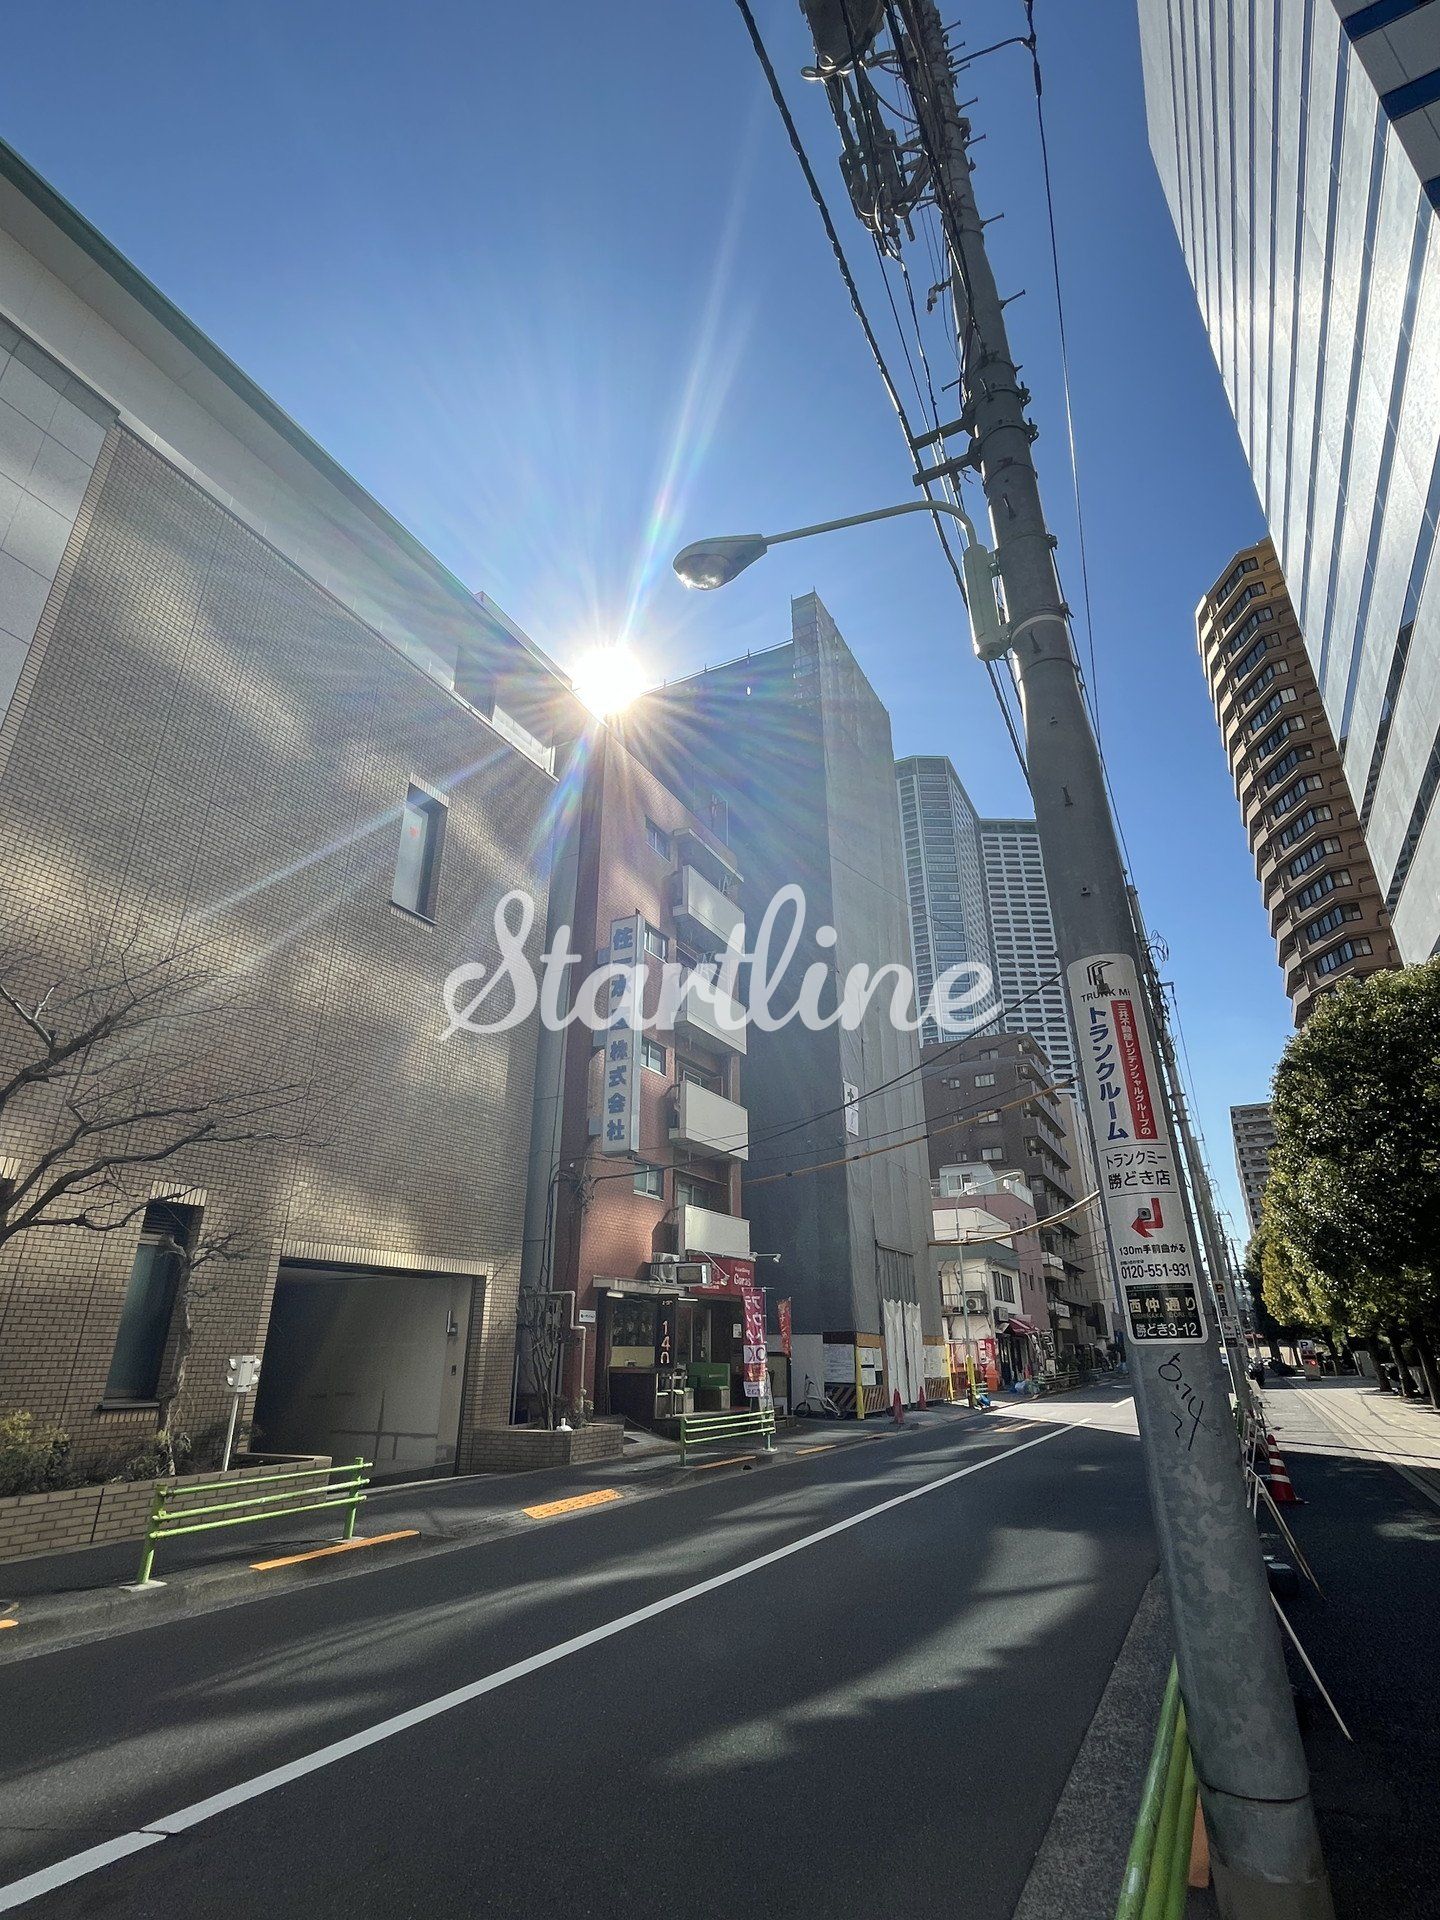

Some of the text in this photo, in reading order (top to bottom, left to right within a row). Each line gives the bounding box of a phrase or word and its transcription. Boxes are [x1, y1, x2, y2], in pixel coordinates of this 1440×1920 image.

[1089, 1006, 1129, 1140] トランクルーム
[1105, 1150, 1167, 1169] トランクミー
[1108, 1169, 1171, 1190] 勝どき店
[1119, 1244, 1186, 1256] 130m手前曲がる
[1121, 1263, 1191, 1279] 0120-551-931
[1128, 1296, 1196, 1313] 西仲通り
[1136, 1322, 1198, 1337] 勝どき3-12
